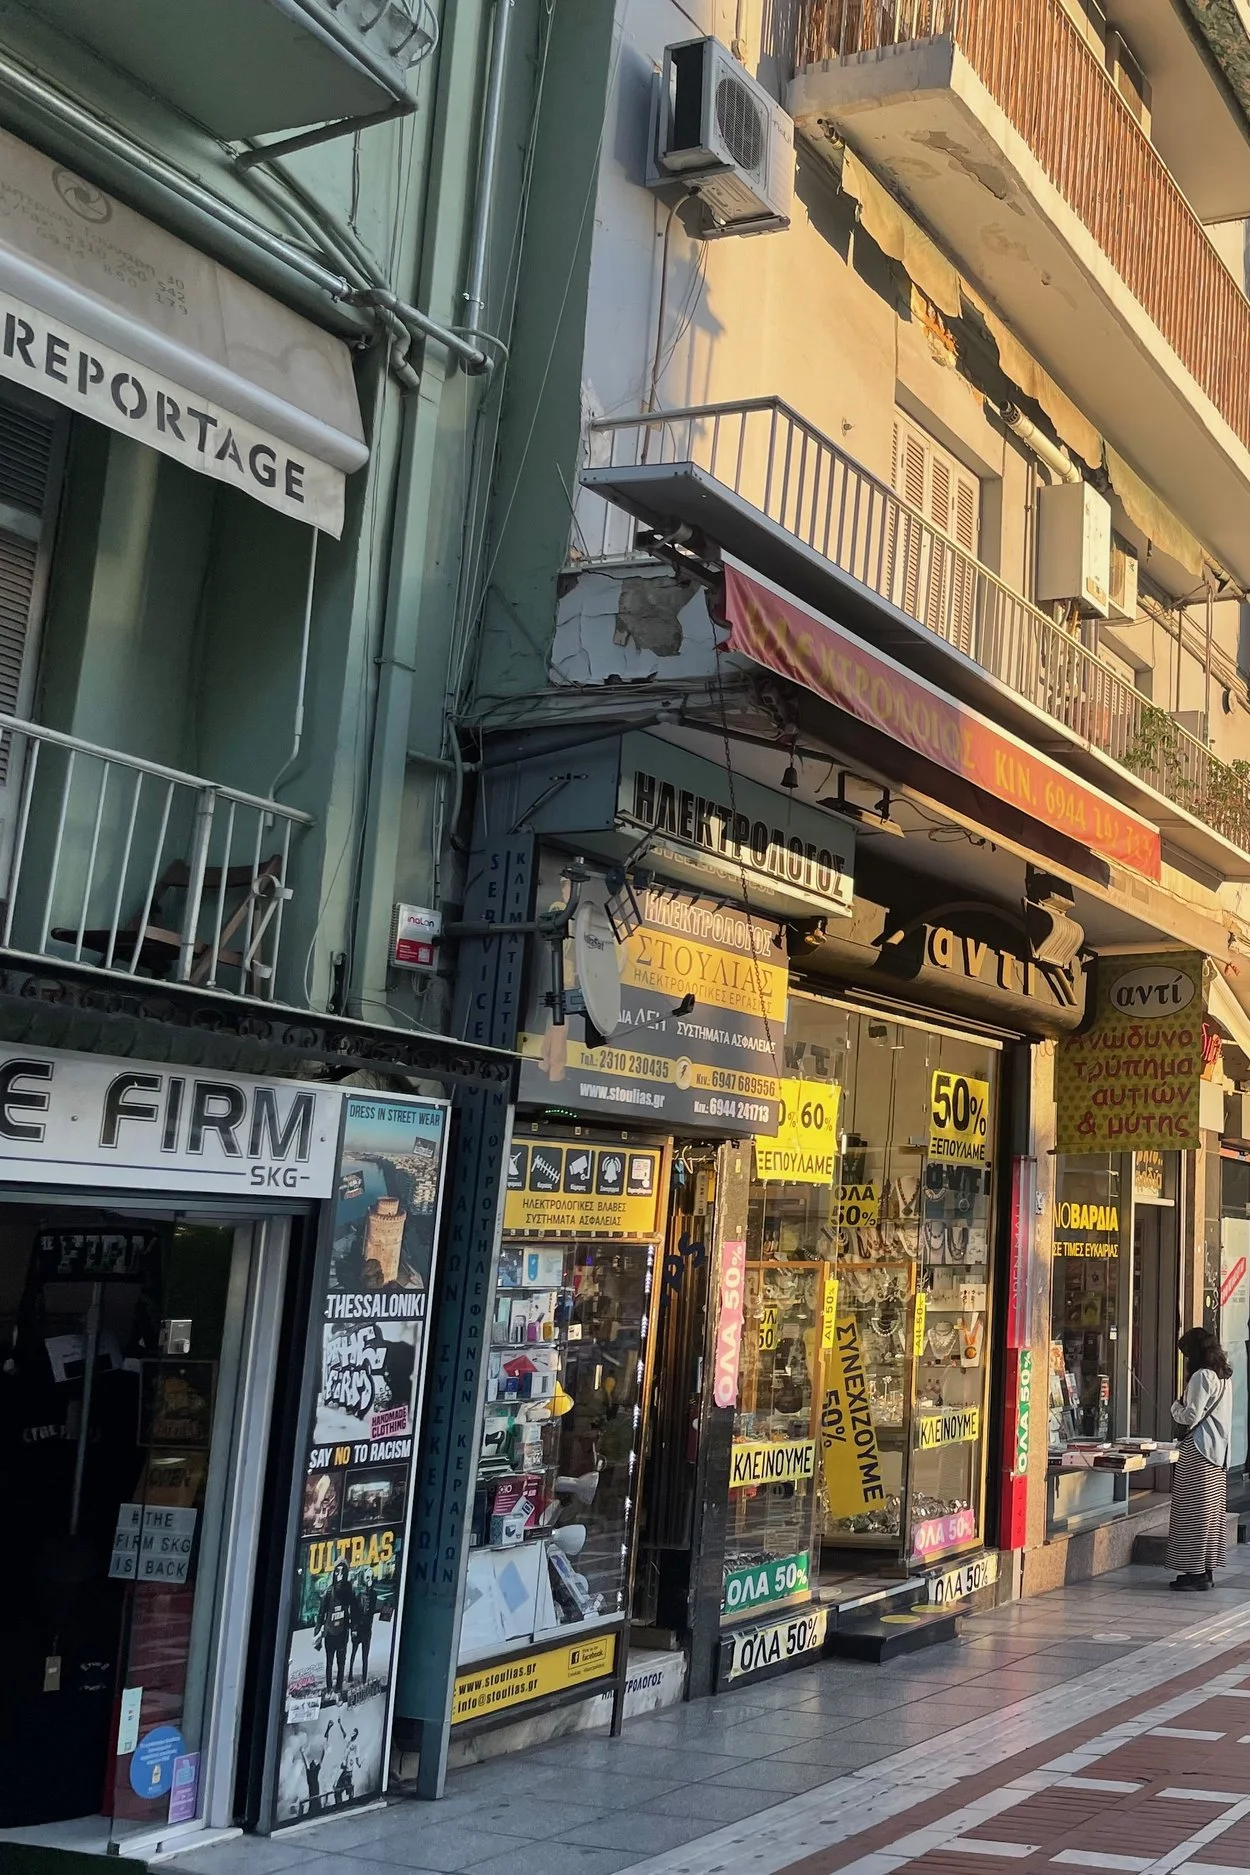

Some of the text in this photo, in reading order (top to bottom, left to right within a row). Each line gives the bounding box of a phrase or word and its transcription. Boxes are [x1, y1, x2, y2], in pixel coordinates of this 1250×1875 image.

[3, 313, 305, 503] REPORTAGE
[634, 770, 846, 898] ΗΛΕΚΤΡΟΛΟΓΟΣ
[644, 891, 773, 956] ΗΛΕΚΤΡΟΛΟΓΟΣ
[636, 933, 774, 998] ΣΤΟΥΛΙΑΣ
[633, 968, 727, 1003] ΗΛΕΚΤΡΟΛΟΓΙΚΕΣ
[1116, 976, 1183, 1009] αντί
[676, 1021, 730, 1045] ΣΥΣΤΗΜΑΤΑ
[731, 1033, 776, 1054] ΑΣΦΑΛΕΙΑΣ
[600, 1050, 626, 1071] 2310
[629, 1056, 669, 1079] 230435
[711, 1070, 736, 1090] 6947
[738, 1074, 776, 1097] 689556
[1073, 1054, 1193, 1083] τρύπημα
[579, 1082, 666, 1108] www.stoulias.gr
[709, 1098, 735, 1119] 6944
[737, 1100, 770, 1121] 241713
[931, 1073, 988, 1137] 50%
[1092, 1081, 1192, 1105] αυτιών
[99, 1070, 318, 1163] FIRM
[349, 1104, 441, 1127] DRESS IN STREET WEAR
[801, 1101, 833, 1132] 60%
[1077, 1110, 1190, 1138] & μύτης
[757, 1150, 833, 1176] ΞΕΠΟΥΛΑΜΕ
[930, 1136, 986, 1162] ΞΕΠΟΥΛΑΜΕ
[522, 1198, 627, 1213] ΗΛΕΚΤΡΟΛΟΓΙΚΕΣ ΒΛΑΒΕΣ
[835, 1185, 875, 1202] ΟΛΑ
[526, 1213, 622, 1227] ΣΥΣΤΗΜΑΤΑ ΑΣΦΑΛΕΙΑΣ
[831, 1204, 877, 1227] 50%
[1064, 1242, 1085, 1257] ΤΙΜΕΣ
[1085, 1243, 1119, 1258] ΕΥΚΑΙΡΙΑΣ
[326, 1293, 426, 1319] THESSALONIKI
[718, 1246, 744, 1402] ΟΛΑ 50%
[371, 1407, 407, 1427] HANDMADE
[371, 1419, 408, 1439] CLOTHING
[821, 1388, 847, 1449] 50%
[836, 1322, 885, 1503] ΣΥΝΕΧΙΖΟΥΜΕ
[1018, 1351, 1032, 1473] ΟΛΑ 50%
[920, 1411, 978, 1448] ΚΛΕΙΝΟΥΜΕ
[309, 1439, 412, 1469] SAY NO TO RACISM
[733, 1445, 813, 1482] ΚΛΕΙΝΟΥΜΕ
[115, 1534, 191, 1553] FIRM SKG
[914, 1517, 973, 1551] ΟΛΑ 50%
[115, 1557, 186, 1577] IS BACK
[308, 1531, 395, 1575] ULTRAS
[727, 1561, 808, 1605] ΟΛΑ 50%
[934, 1559, 989, 1602] ΟΛΑ 50%
[740, 1616, 819, 1672] ΟΛΑ 50%
[458, 1661, 537, 1695] www.stoulias.gr
[457, 1678, 539, 1714] info@stoulias.gr
